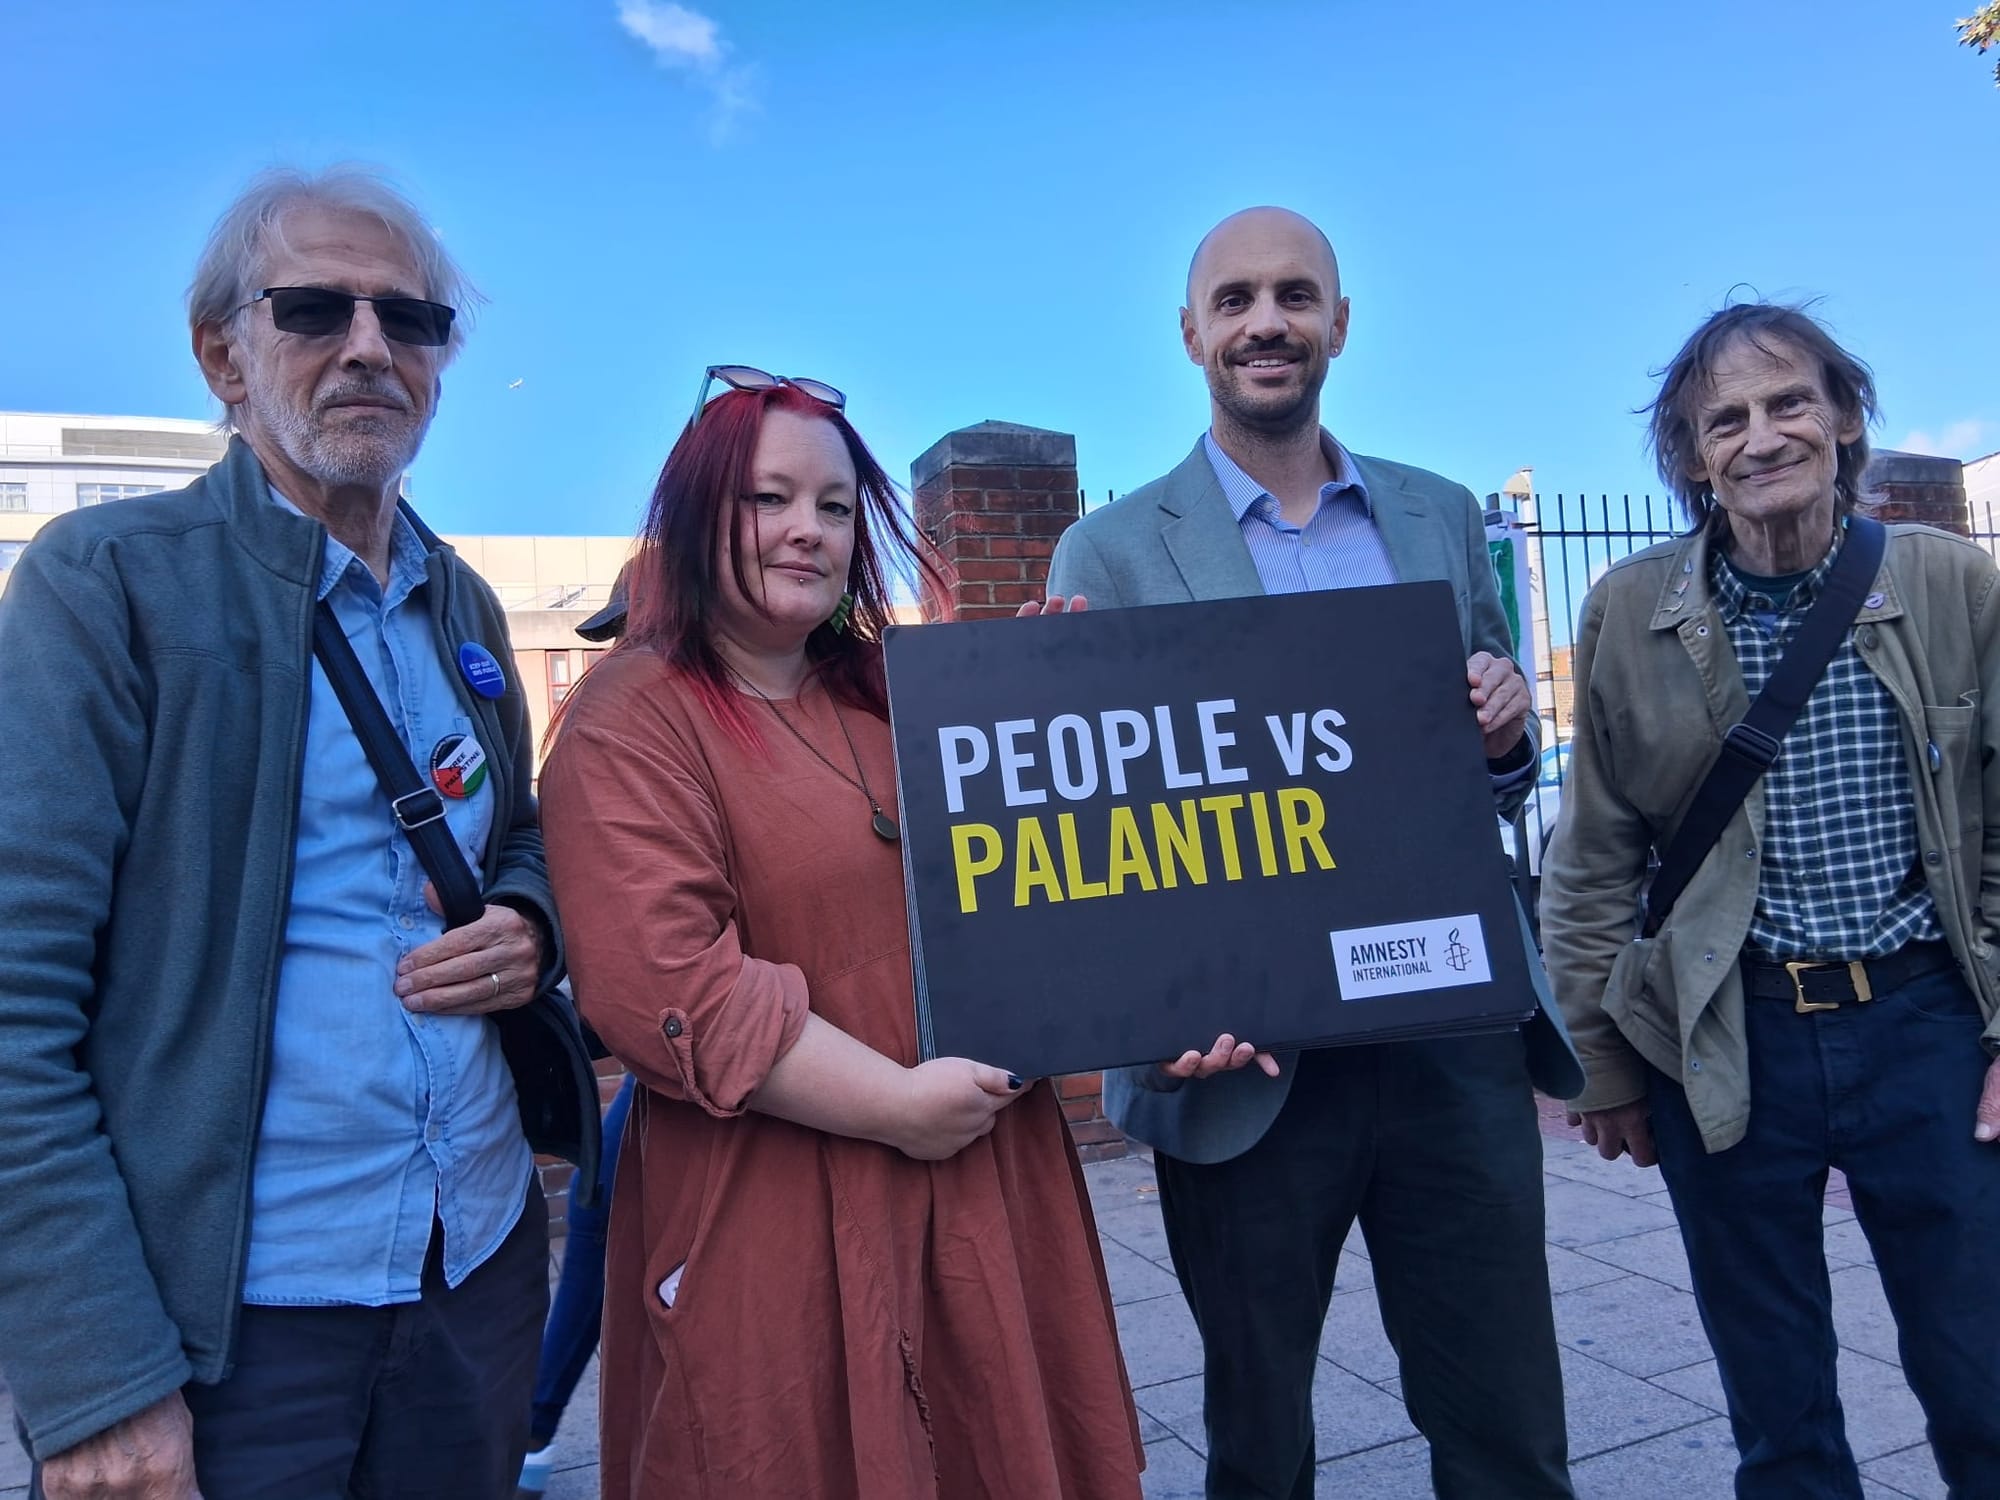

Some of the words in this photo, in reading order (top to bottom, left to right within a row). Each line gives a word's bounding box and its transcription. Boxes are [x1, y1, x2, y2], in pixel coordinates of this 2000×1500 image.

[444, 750, 481, 789] PALESTINE
[449, 752, 467, 771] FREE
[938, 699, 1249, 813] PEOPLE
[951, 788, 1336, 913] PALANTIR
[1350, 936, 1426, 966] AMNESTY
[1352, 961, 1432, 982] INTERNATIONAL
